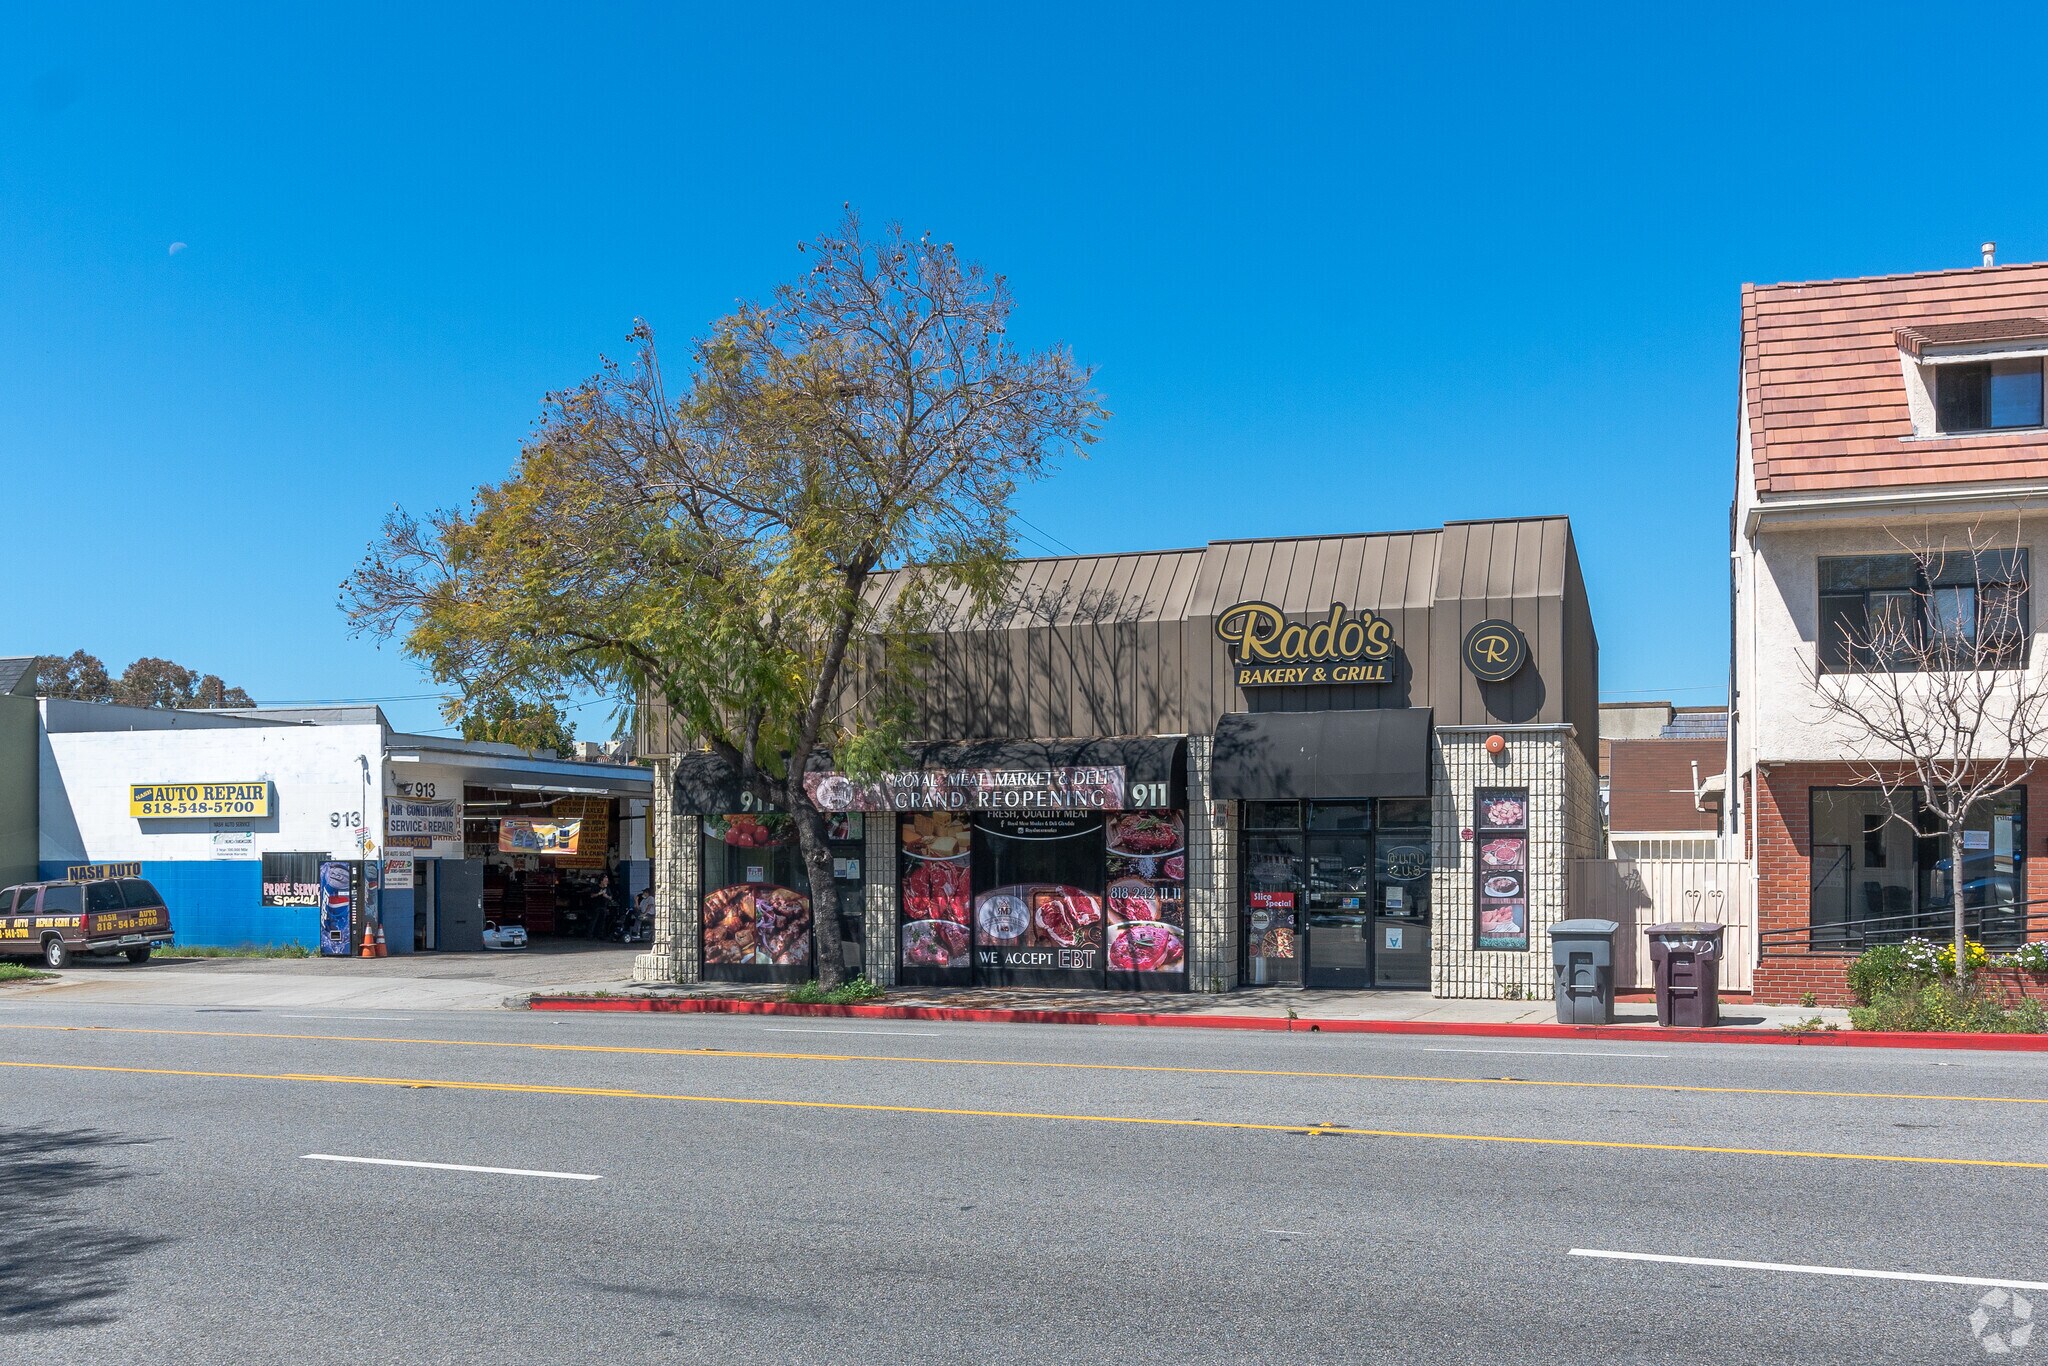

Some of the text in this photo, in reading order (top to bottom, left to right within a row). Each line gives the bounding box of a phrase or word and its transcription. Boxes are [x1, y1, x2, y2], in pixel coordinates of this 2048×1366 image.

[1218, 604, 1390, 659] Rado's
[1475, 635, 1509, 663] R
[1238, 665, 1385, 685] BAKERY & GRILL
[893, 770, 1109, 788] ROYAL MEAT MARKET & DELI
[155, 785, 264, 801] AUTO REPAIR
[416, 782, 436, 798] 913
[1132, 783, 1167, 806] 911
[895, 790, 1105, 808] GRAND REOPENING
[143, 802, 254, 814] 818-548-5700
[391, 804, 403, 816] AIR
[406, 805, 453, 817] CONDITIONING
[330, 811, 362, 828] 913
[391, 820, 422, 832] SERVICE
[428, 821, 453, 832] REPAIR
[70, 862, 141, 880] NASH AUTO
[849, 861, 856, 870] A
[293, 882, 320, 896] SERVIC
[1111, 887, 1181, 899] 818 242 11 11
[1254, 892, 1272, 900] Slice
[273, 895, 317, 907] Special
[1265, 900, 1291, 908] Special
[98, 909, 157, 922] NASH AUTO
[13, 918, 29, 928] AUTO
[1390, 938, 1399, 947] A
[979, 950, 1095, 968] WE ACCEPT EBT
